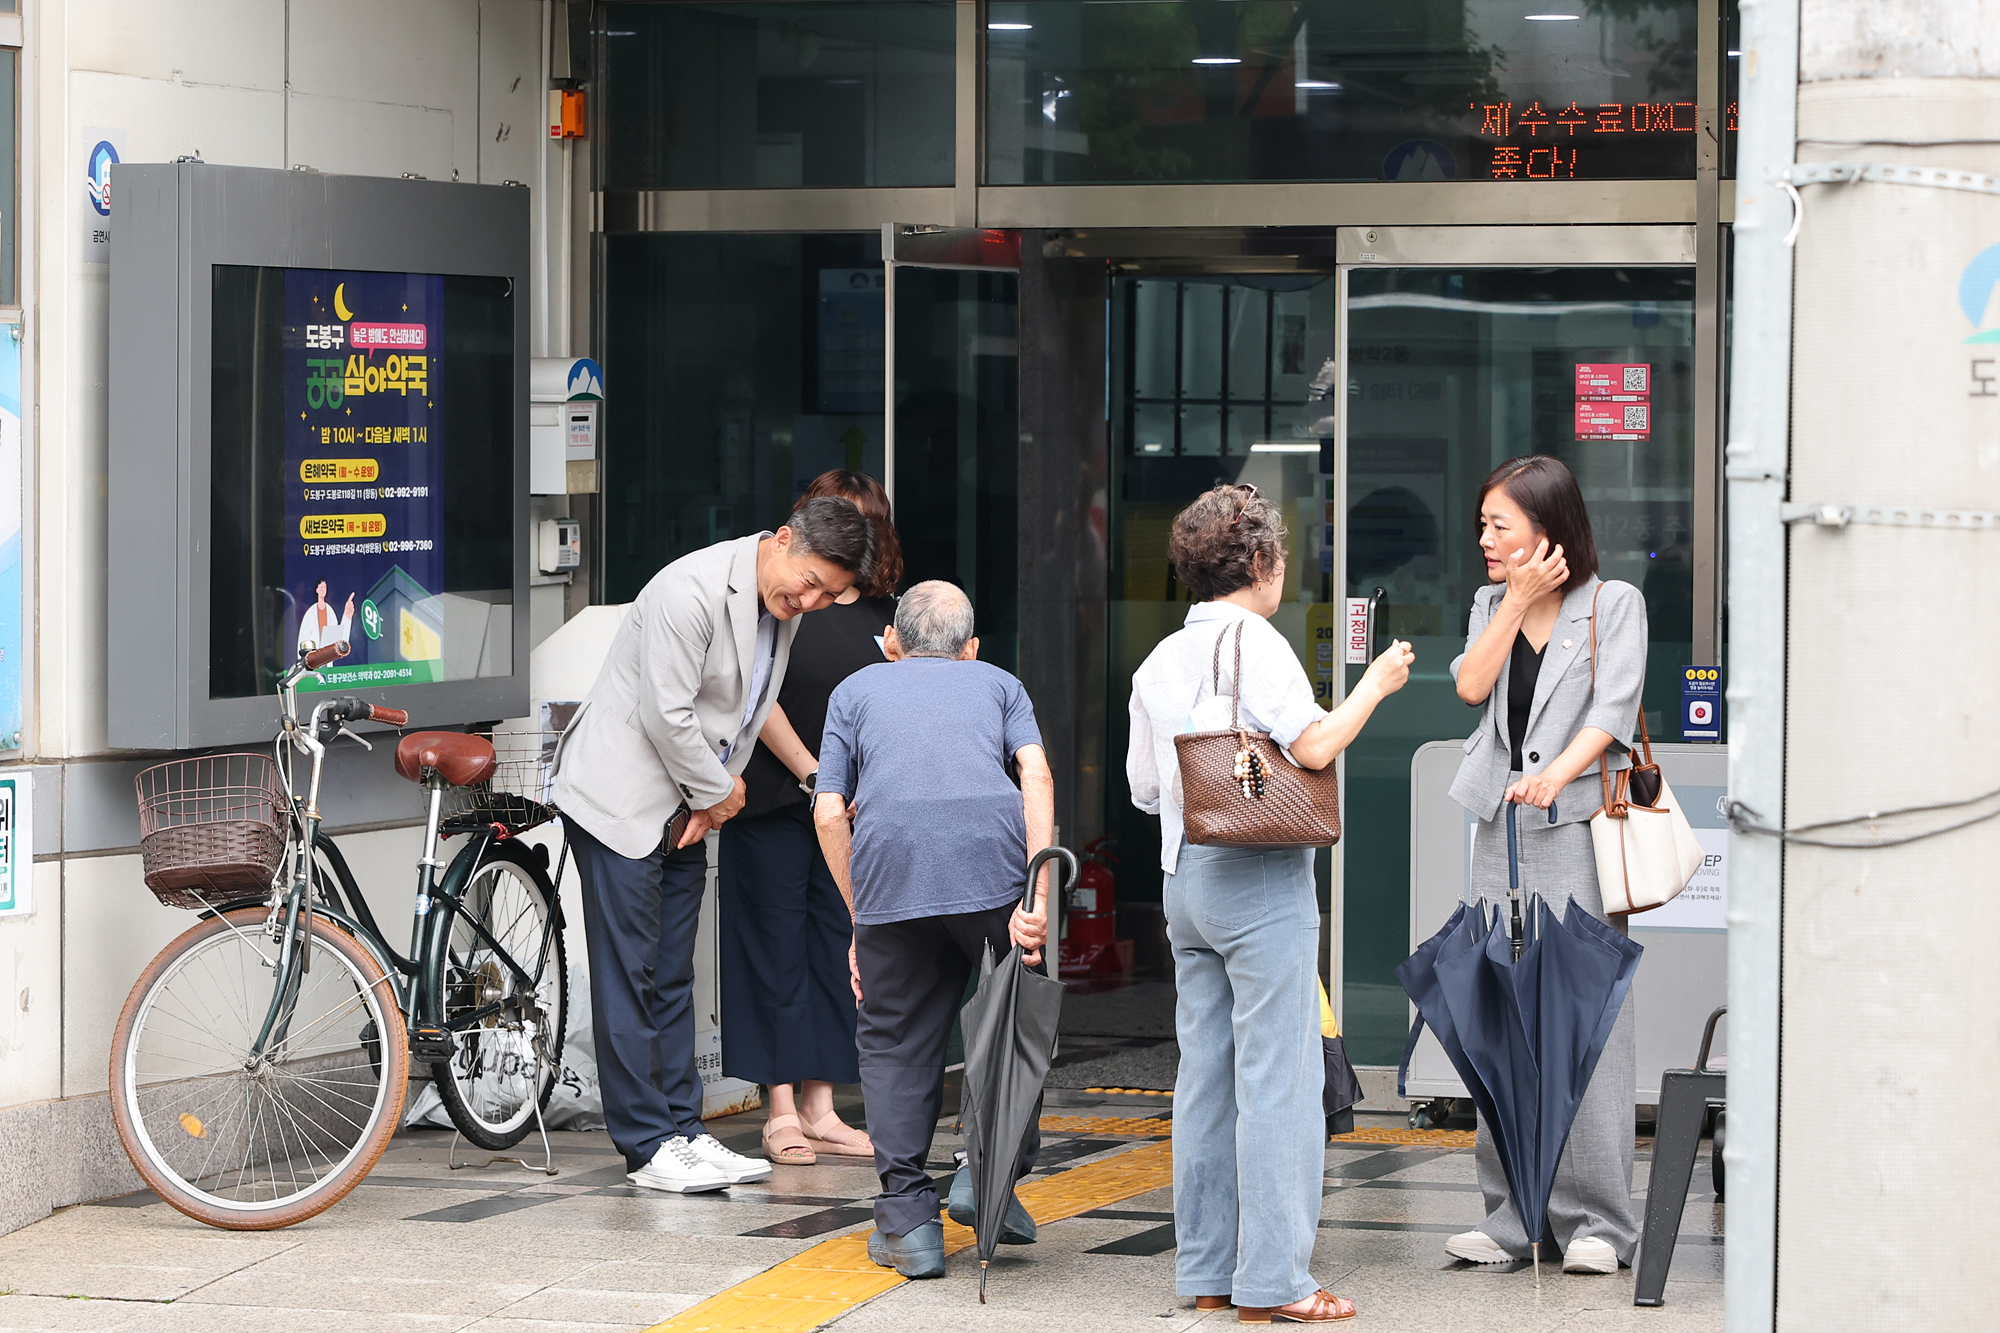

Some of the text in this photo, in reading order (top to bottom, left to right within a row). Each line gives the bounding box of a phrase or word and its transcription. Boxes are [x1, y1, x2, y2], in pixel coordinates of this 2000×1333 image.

[1492, 146, 1577, 178] 좋다!
[306, 324, 344, 350] 도봉구
[353, 327, 424, 344] 늦은 밤에도 안심하세요!
[1968, 359, 1998, 397] 도
[321, 427, 331, 444] 밤
[333, 427, 355, 444] 10시
[365, 426, 392, 444] 다음날
[393, 427, 410, 444] 새벽
[413, 426, 427, 443] 1시
[304, 463, 336, 478] 은혜약국
[354, 466, 360, 478] 수
[361, 466, 375, 478] 운영)
[310, 489, 326, 500] 도봉구
[385, 486, 429, 498] 02-992-9191
[305, 519, 345, 534] 새보은약국
[368, 520, 382, 533] 운영)
[310, 545, 325, 556] 도봉구
[365, 605, 378, 634] 약
[1350, 604, 1367, 650] 고정문
[327, 671, 357, 684] 도봉구보건소
[374, 668, 412, 680] 02-2091-4514
